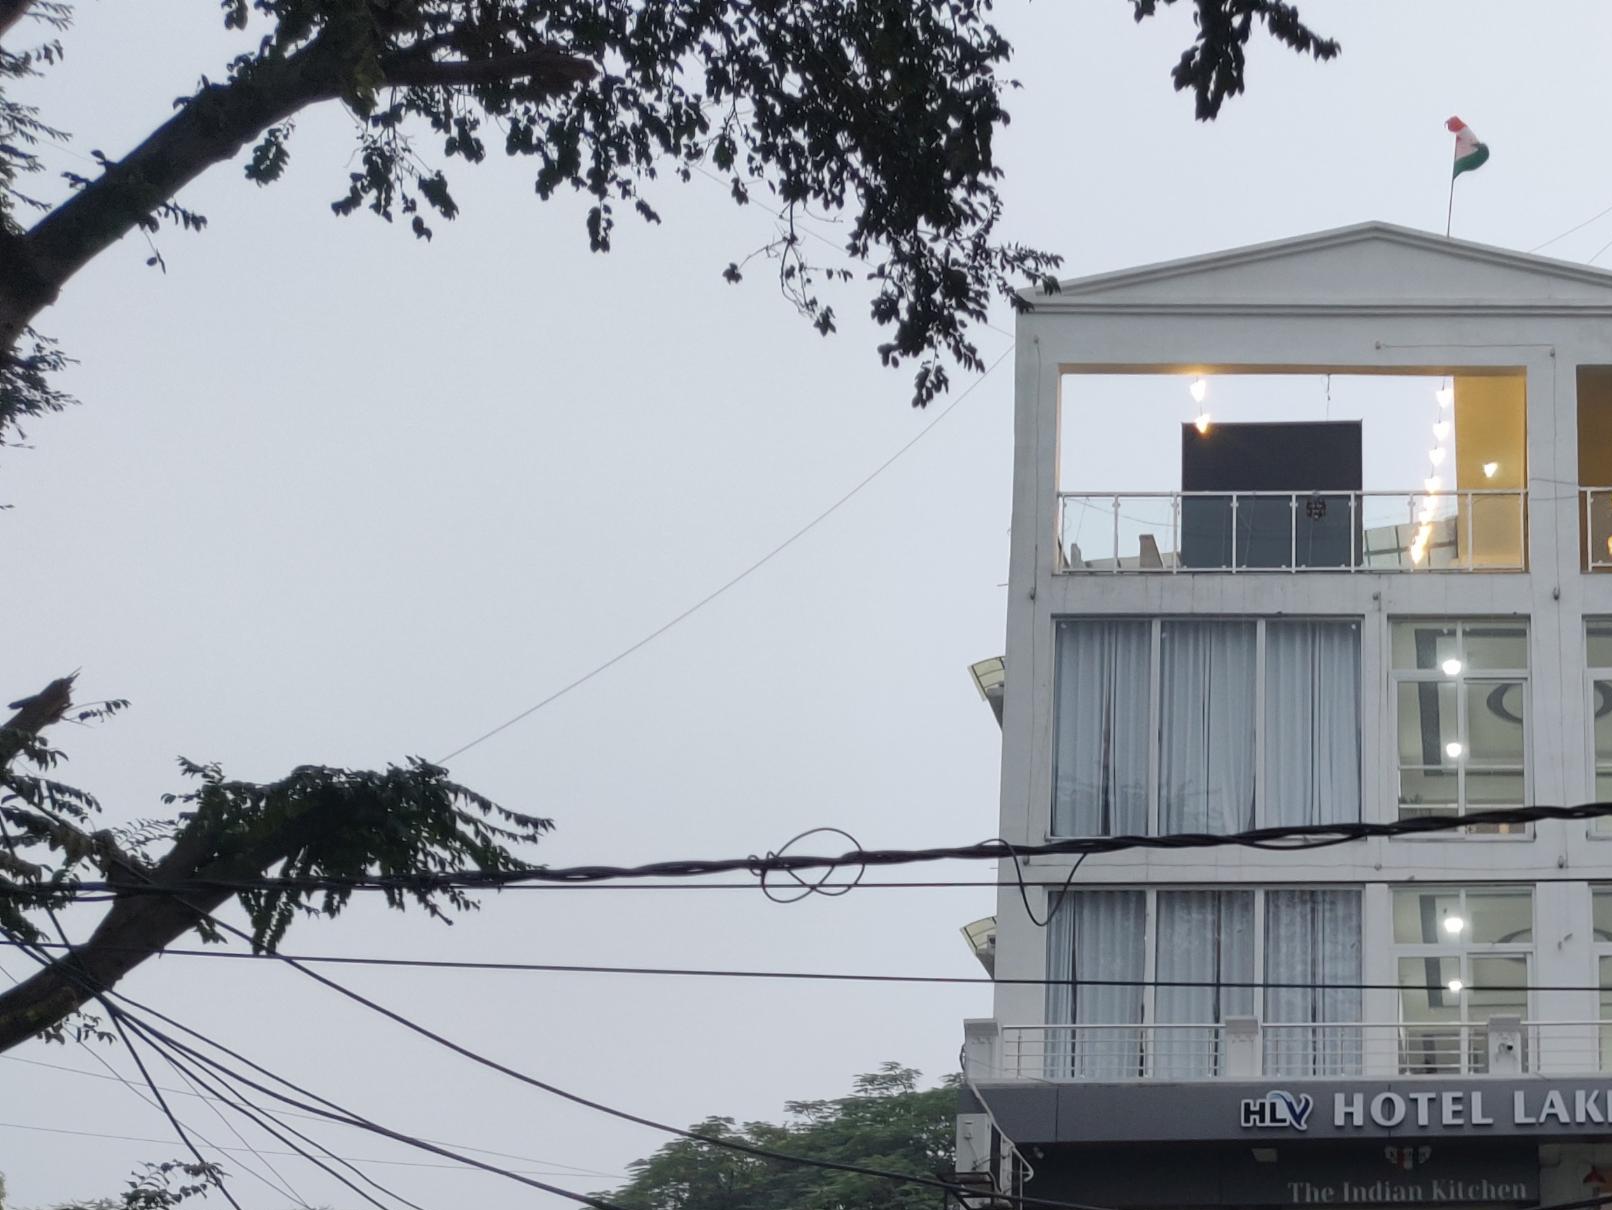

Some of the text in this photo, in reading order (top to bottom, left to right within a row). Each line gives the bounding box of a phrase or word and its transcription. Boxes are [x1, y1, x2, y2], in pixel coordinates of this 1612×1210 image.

[1241, 1090, 1313, 1130] HLV
[1334, 1091, 1495, 1127] HOTEL
[1288, 1178, 1527, 1204] The Indian Kitchen
